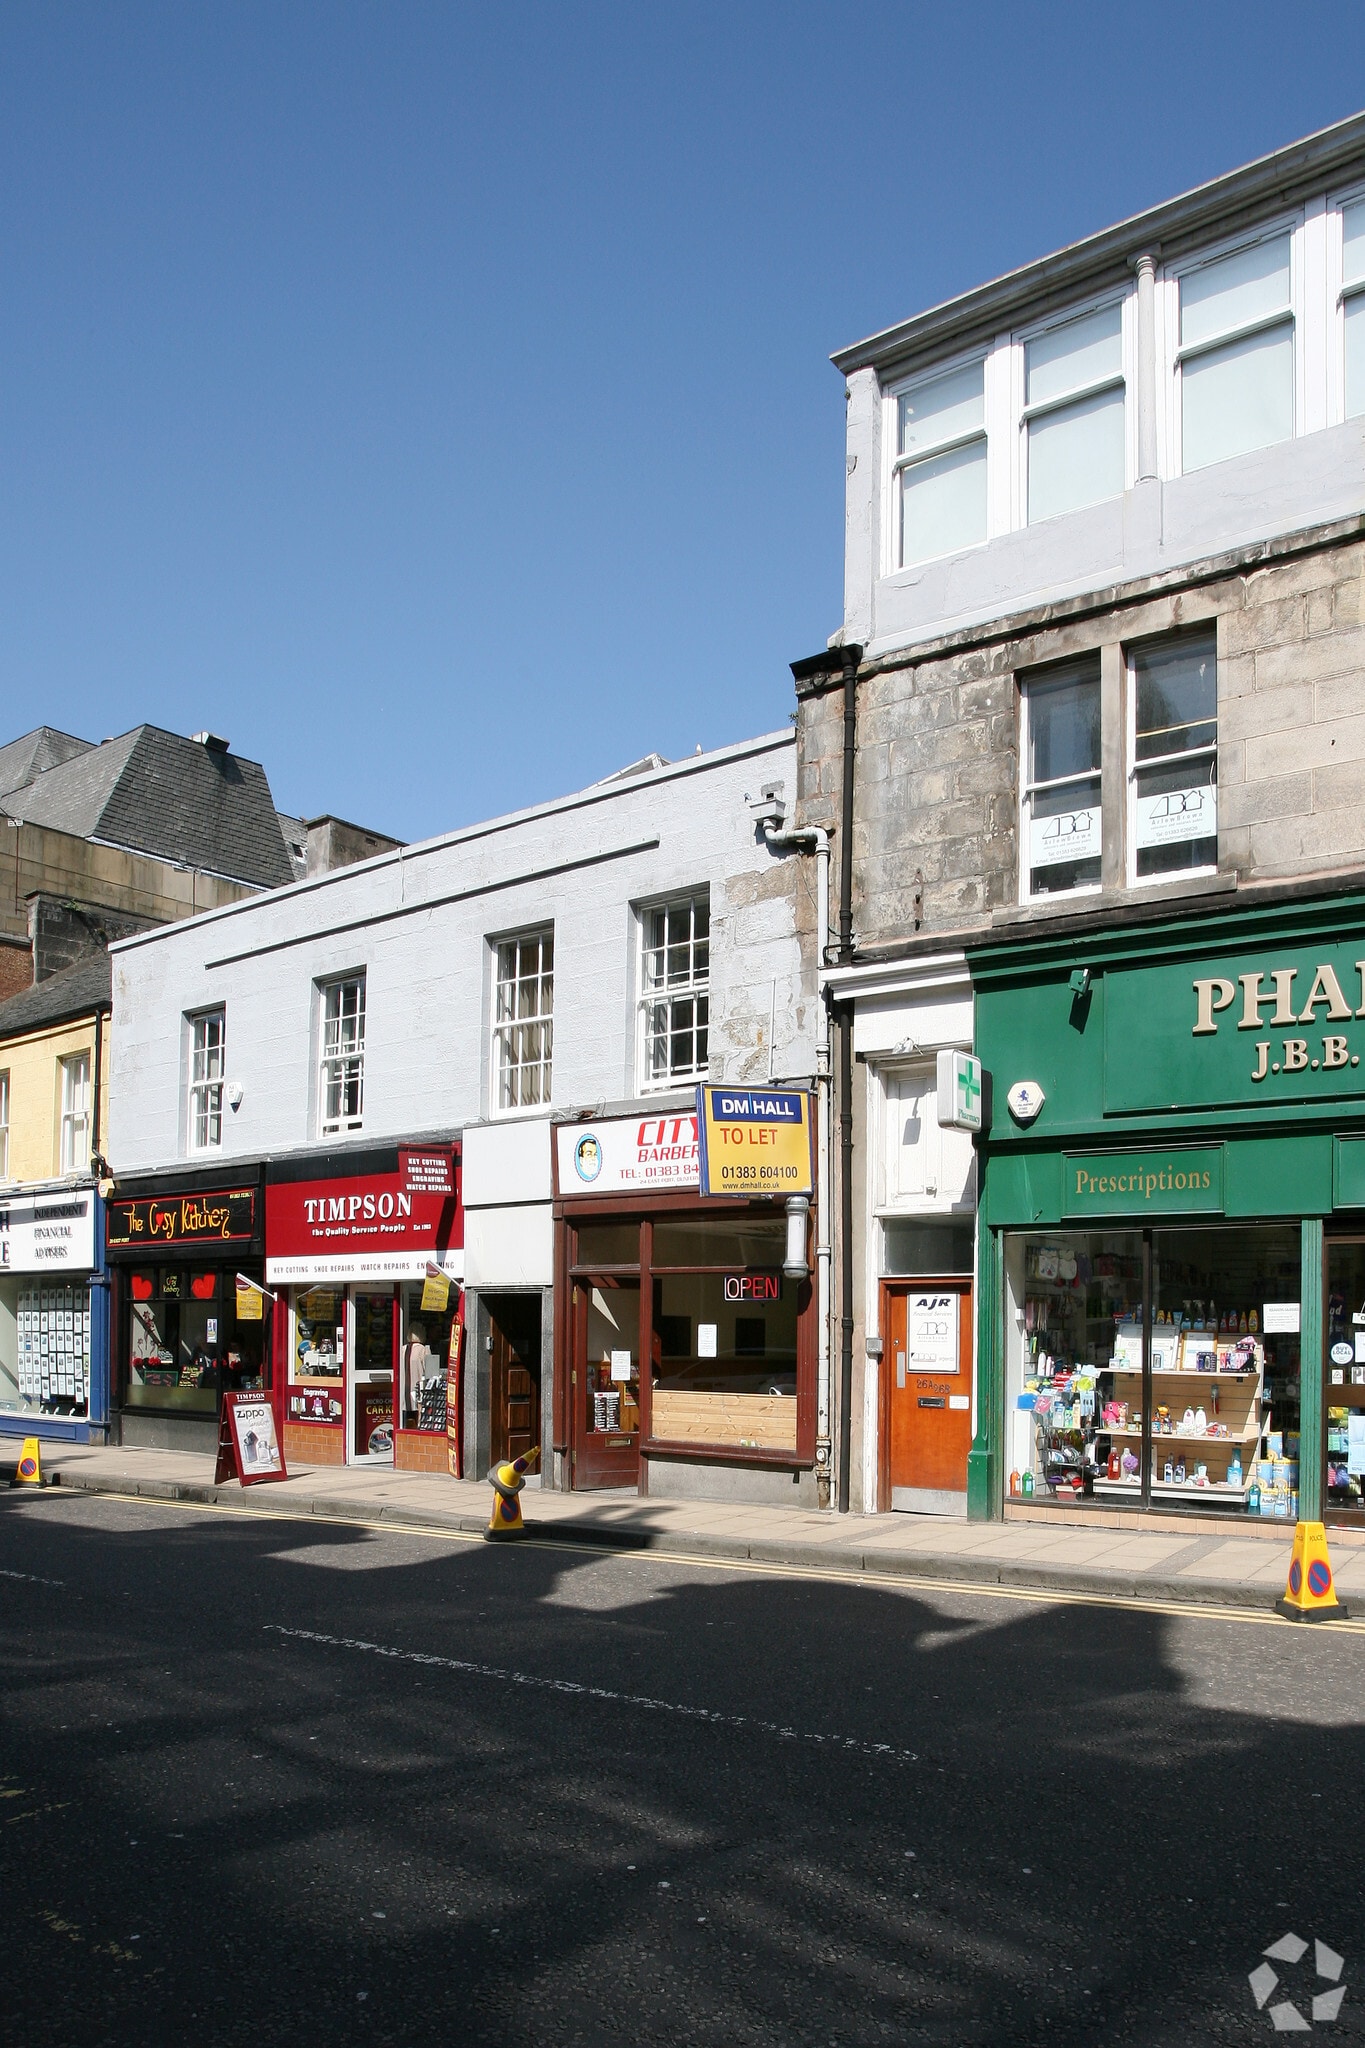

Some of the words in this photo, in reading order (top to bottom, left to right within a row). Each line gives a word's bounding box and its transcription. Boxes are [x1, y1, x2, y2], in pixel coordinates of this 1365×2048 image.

[1251, 1036, 1359, 1079] J.B.B.
[753, 1101, 794, 1116] HALL
[958, 1108, 980, 1125] Pharmacy
[720, 1128, 743, 1145] TO
[749, 1129, 778, 1145] LET
[422, 1158, 446, 1166] CUTTING
[407, 1166, 422, 1174] SHOE
[620, 1169, 642, 1179] TEL:
[645, 1165, 680, 1178] 01383
[722, 1166, 756, 1178] 01383
[760, 1166, 798, 1178] 604100
[428, 1184, 452, 1192] REPAIRS
[722, 1181, 780, 1189] www.dmhall.co.uk
[1075, 1164, 1211, 1199] Prescriptions
[34, 1204, 84, 1219] INDEPENDENT
[304, 1192, 412, 1223] TIMPSON
[123, 1204, 144, 1234] The
[181, 1198, 230, 1239] Kitchen
[34, 1226, 72, 1240] FINANCIAL
[312, 1229, 324, 1237] the
[326, 1227, 350, 1236] Quality
[352, 1225, 378, 1234] Service
[380, 1224, 406, 1233] People
[274, 1266, 284, 1274] KEY
[330, 1264, 354, 1272] REPAIRS
[360, 1263, 381, 1271] WATCH
[384, 1262, 410, 1270] REPAIRS
[727, 1277, 778, 1298] OPEN
[303, 1388, 328, 1398] Engraving
[366, 1405, 384, 1414] CAR
[1310, 1534, 1323, 1542] POLICE
